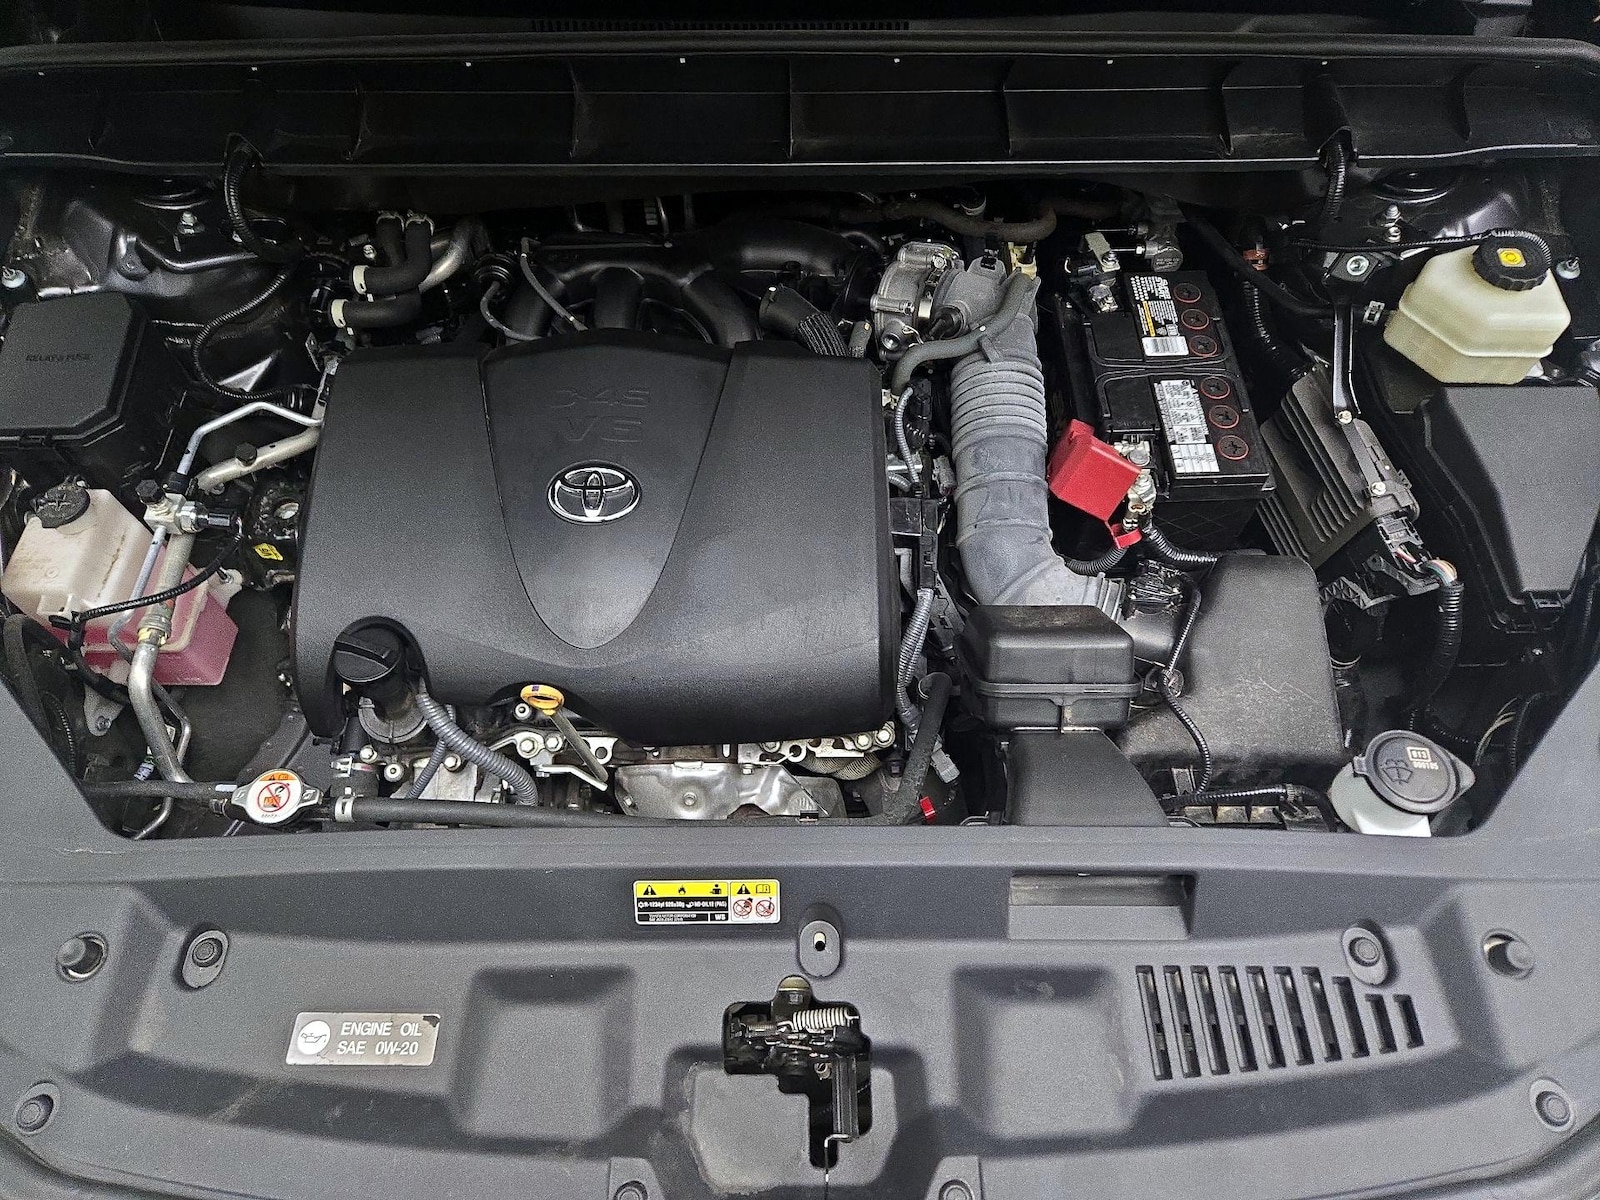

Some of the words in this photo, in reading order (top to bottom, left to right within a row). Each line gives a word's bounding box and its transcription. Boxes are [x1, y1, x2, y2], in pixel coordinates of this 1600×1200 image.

[340, 1022, 393, 1036] ENGINE
[400, 1022, 423, 1037] OIL
[336, 1040, 367, 1055] SAE
[375, 1040, 419, 1056] 0W-20
